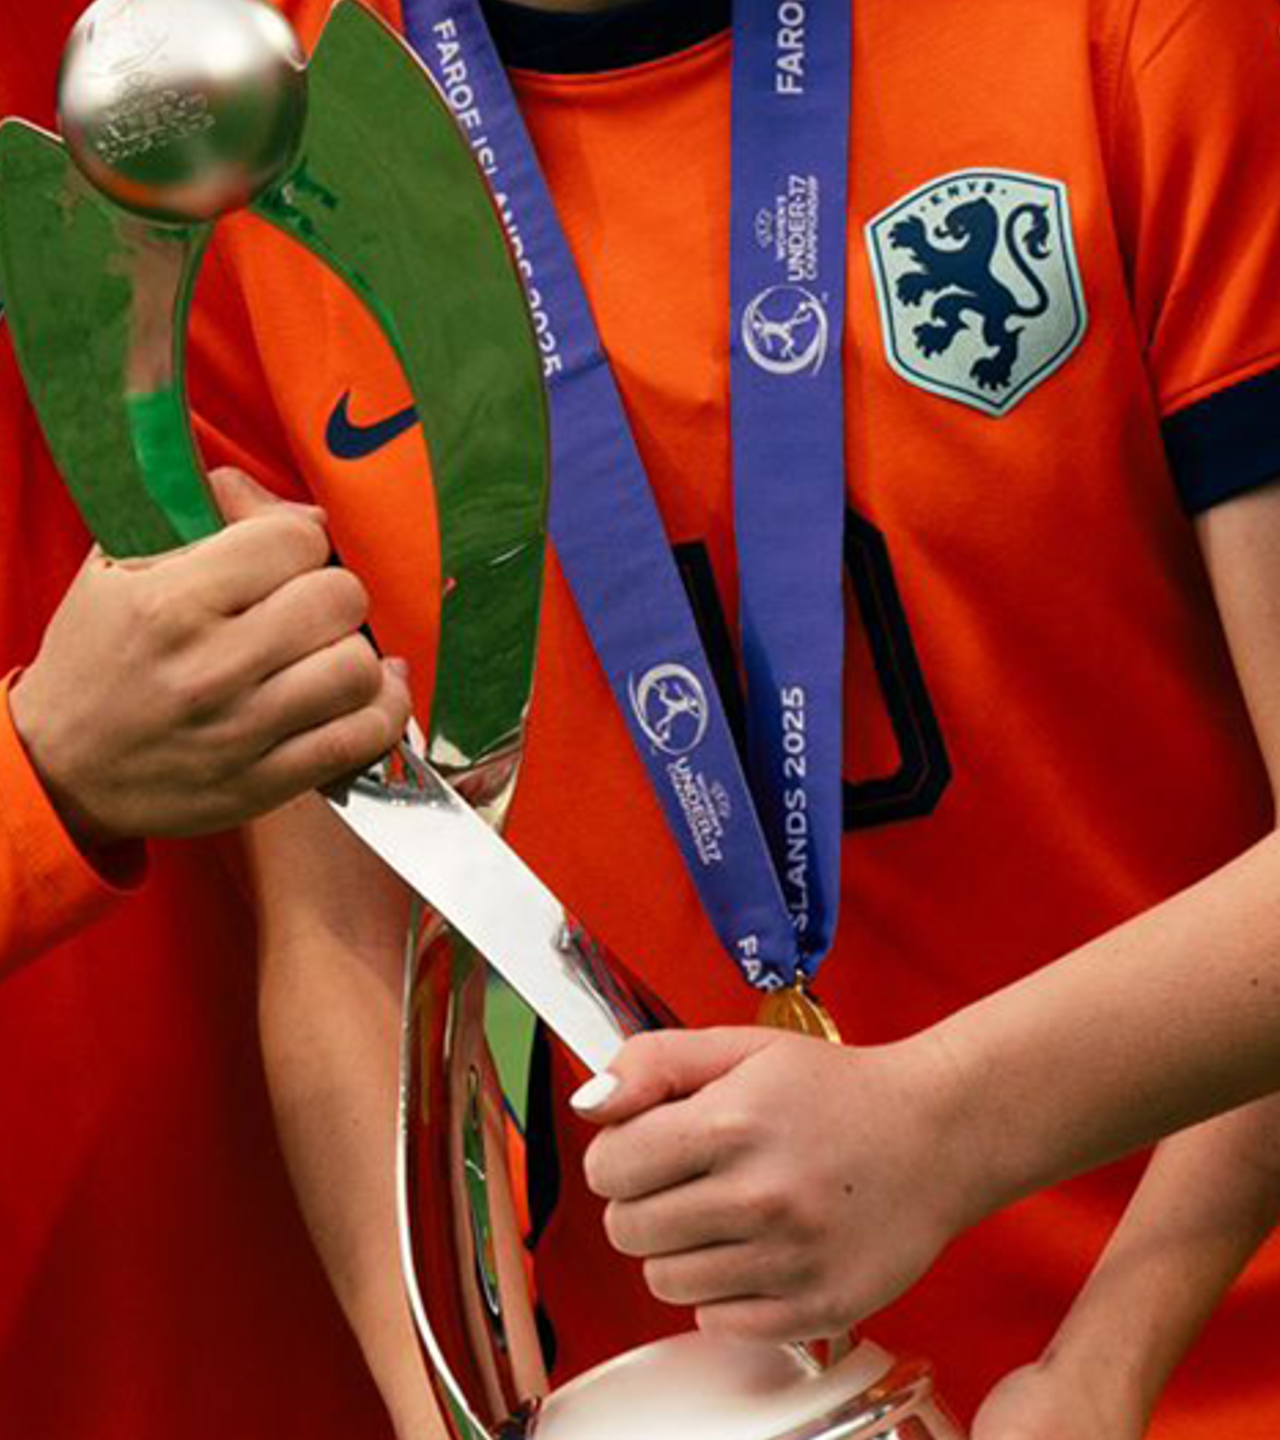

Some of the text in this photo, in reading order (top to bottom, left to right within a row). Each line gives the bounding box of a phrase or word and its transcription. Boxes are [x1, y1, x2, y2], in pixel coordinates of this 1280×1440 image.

[787, 174, 806, 281] UNDER-17
[780, 686, 808, 932] SLANDS 2025
